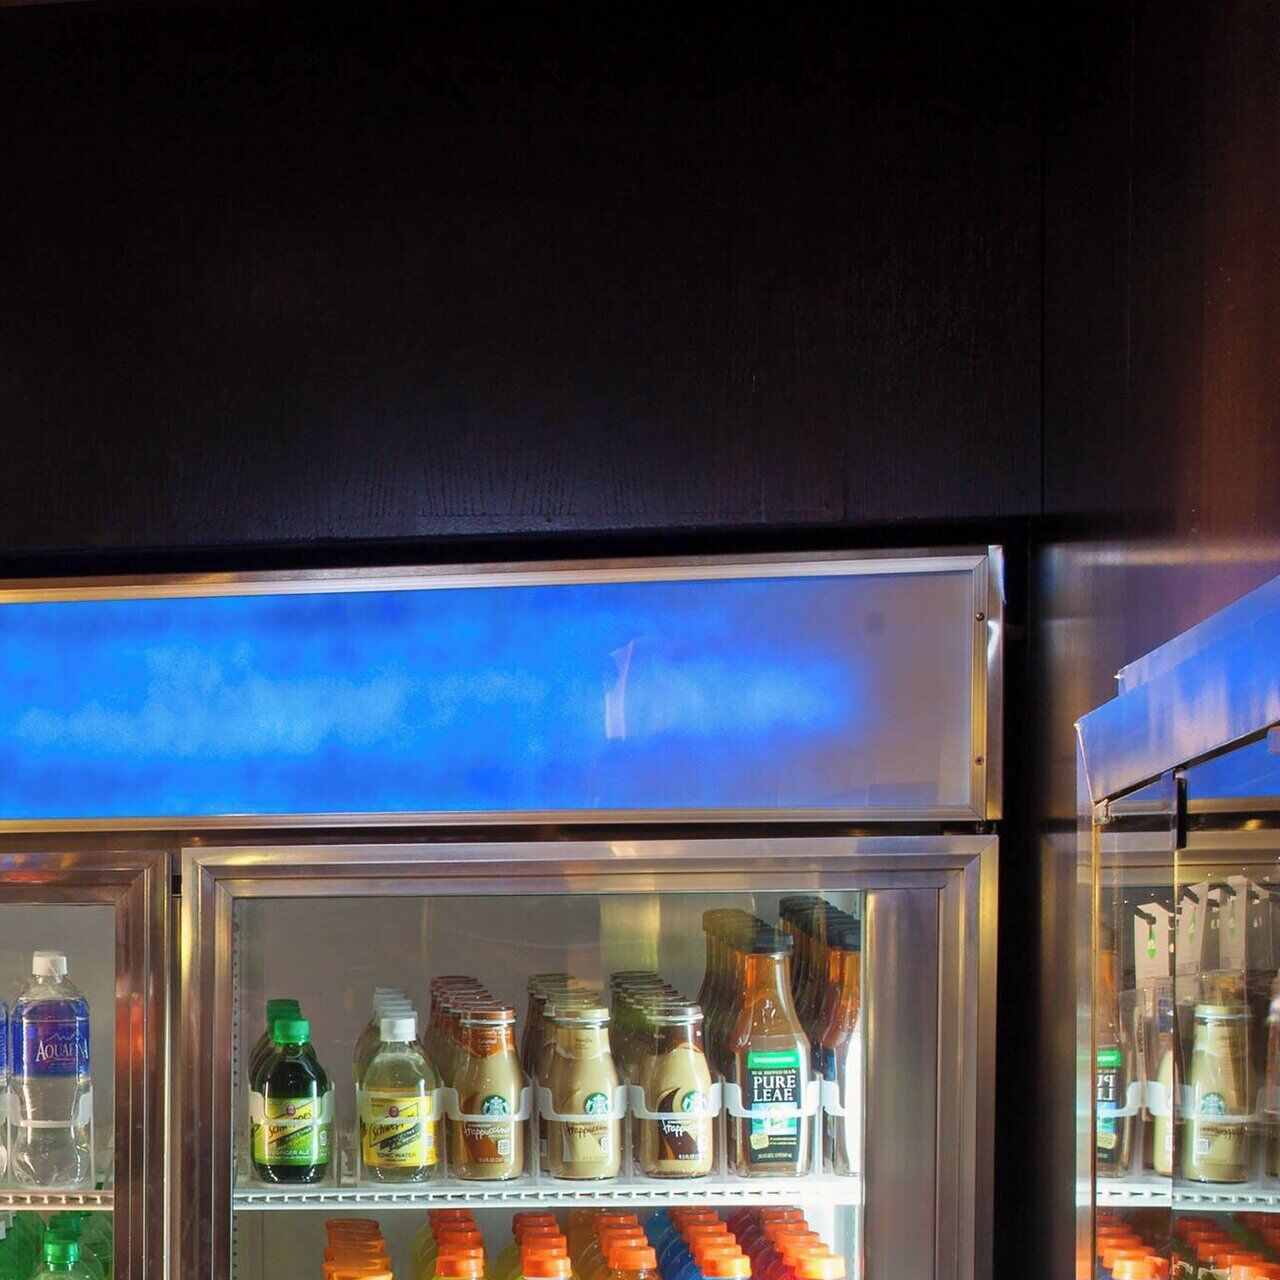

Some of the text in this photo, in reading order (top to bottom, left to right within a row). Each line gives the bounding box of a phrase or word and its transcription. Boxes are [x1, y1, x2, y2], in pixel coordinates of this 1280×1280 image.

[35, 1040, 89, 1063] AQUAFINA
[753, 1075, 796, 1089] PURE
[753, 1088, 793, 1102] LEAF
